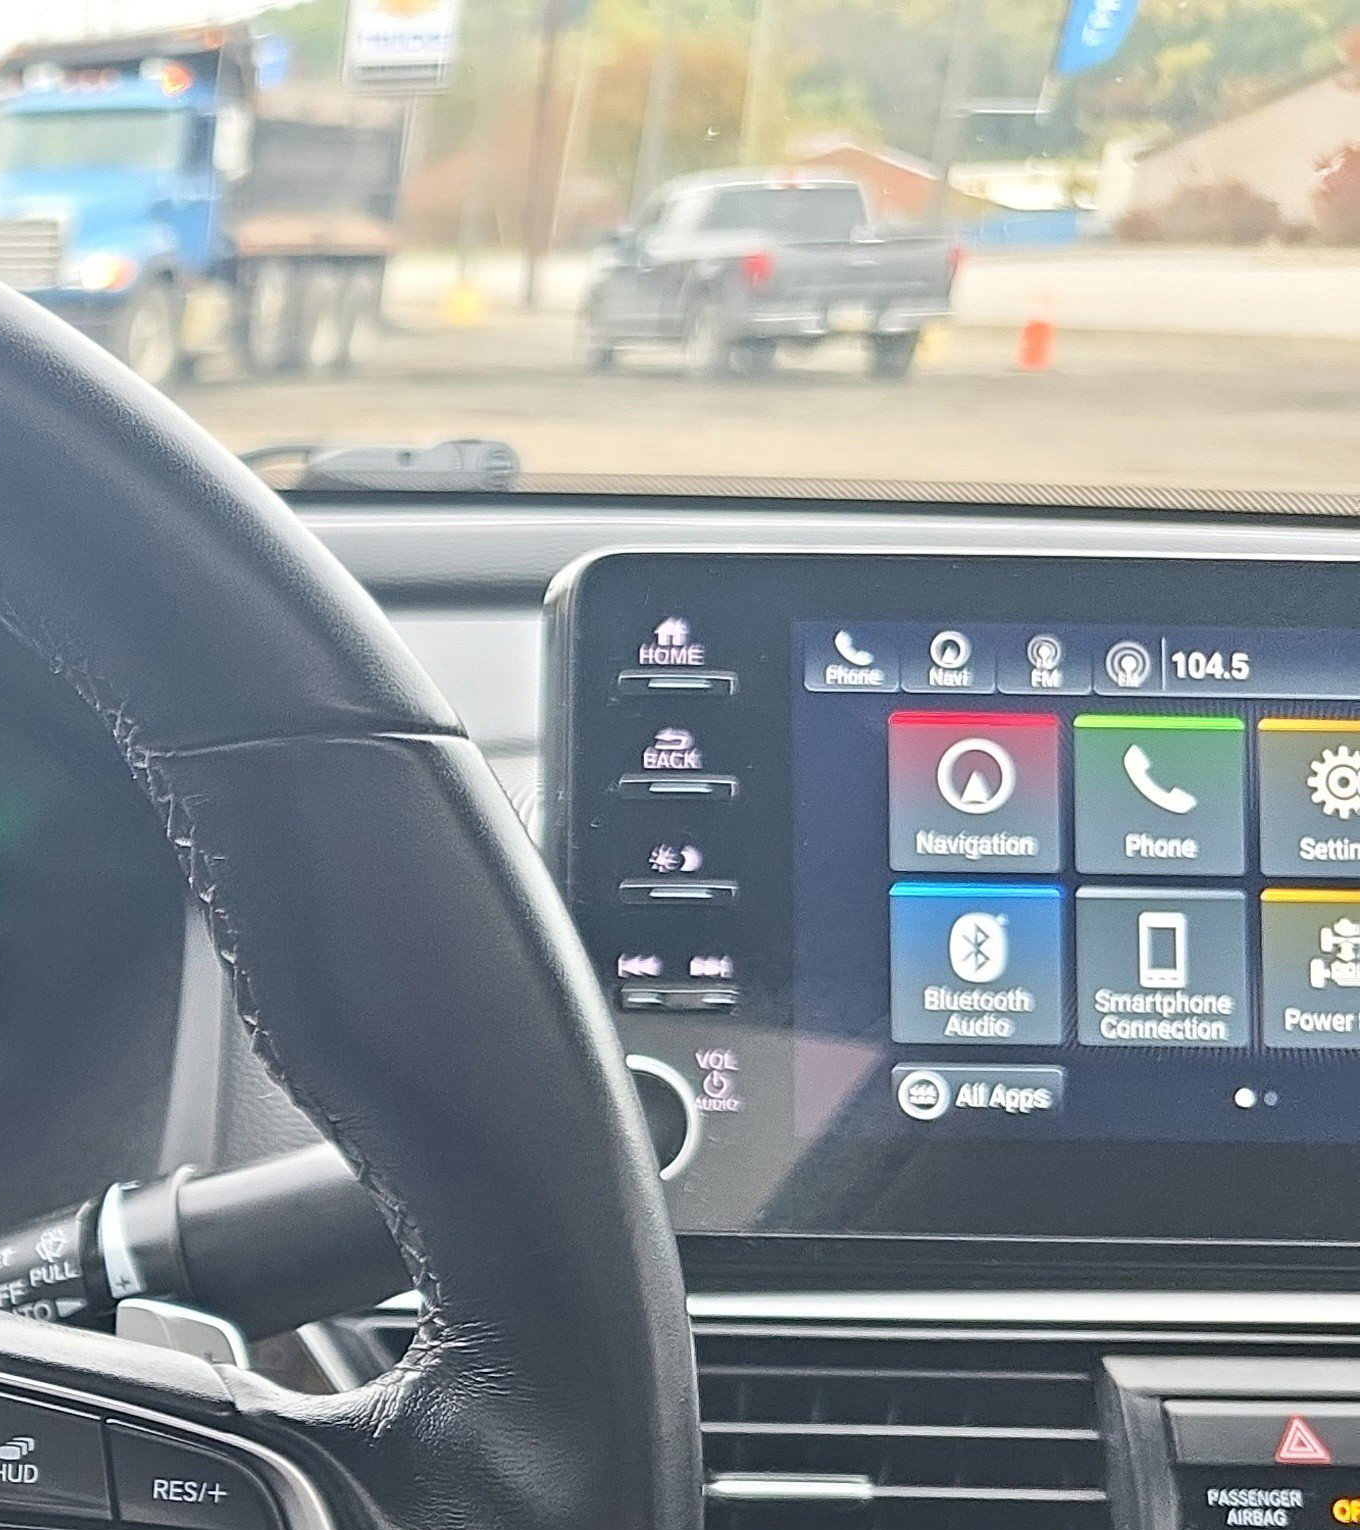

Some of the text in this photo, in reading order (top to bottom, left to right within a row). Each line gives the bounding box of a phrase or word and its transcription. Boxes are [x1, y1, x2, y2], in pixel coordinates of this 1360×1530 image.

[639, 643, 705, 665] HOME
[1171, 651, 1251, 681] 104.5
[826, 667, 884, 686] Phone
[929, 668, 972, 686] Navi
[1030, 669, 1062, 687] FM
[643, 747, 702, 769] BACK
[915, 830, 1037, 858] Navigation
[1125, 833, 1198, 859] Phone
[923, 986, 1033, 1012] Bluetooth
[1094, 988, 1231, 1017] Smartphone
[944, 1013, 1014, 1037] Audio
[1099, 1016, 1228, 1041] Connection
[1284, 1007, 1354, 1032] Power
[695, 1049, 740, 1071] VOL
[955, 1083, 1052, 1112] All Apps
[29, 1261, 80, 1287] PULL
[152, 1480, 228, 1504] RES/+
[1207, 1488, 1303, 1508] PASSENGER
[1226, 1507, 1290, 1528] AIRBAG
